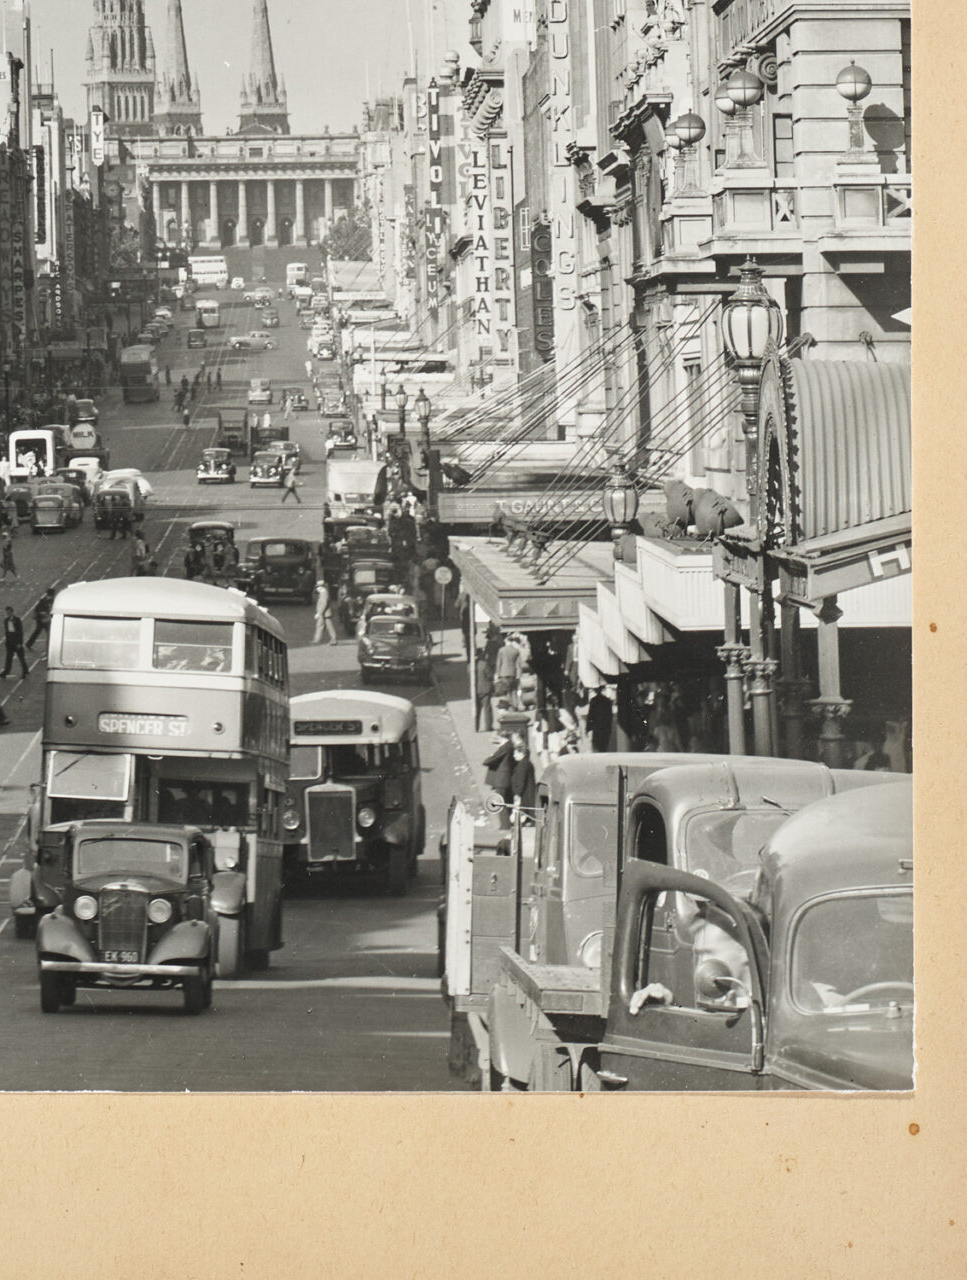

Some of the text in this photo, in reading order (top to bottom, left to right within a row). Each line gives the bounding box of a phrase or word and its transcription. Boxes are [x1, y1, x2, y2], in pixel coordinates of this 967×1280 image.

[92, 113, 104, 160] TYE
[428, 89, 443, 235] TIVOLI
[549, 0, 577, 311] DUNKLINGS
[426, 213, 439, 309] LYCEUM
[472, 150, 491, 335] LEVIATHAN
[490, 144, 511, 352] LIBERTY
[534, 234, 553, 351] COLES
[100, 719, 163, 736] SPENCER
